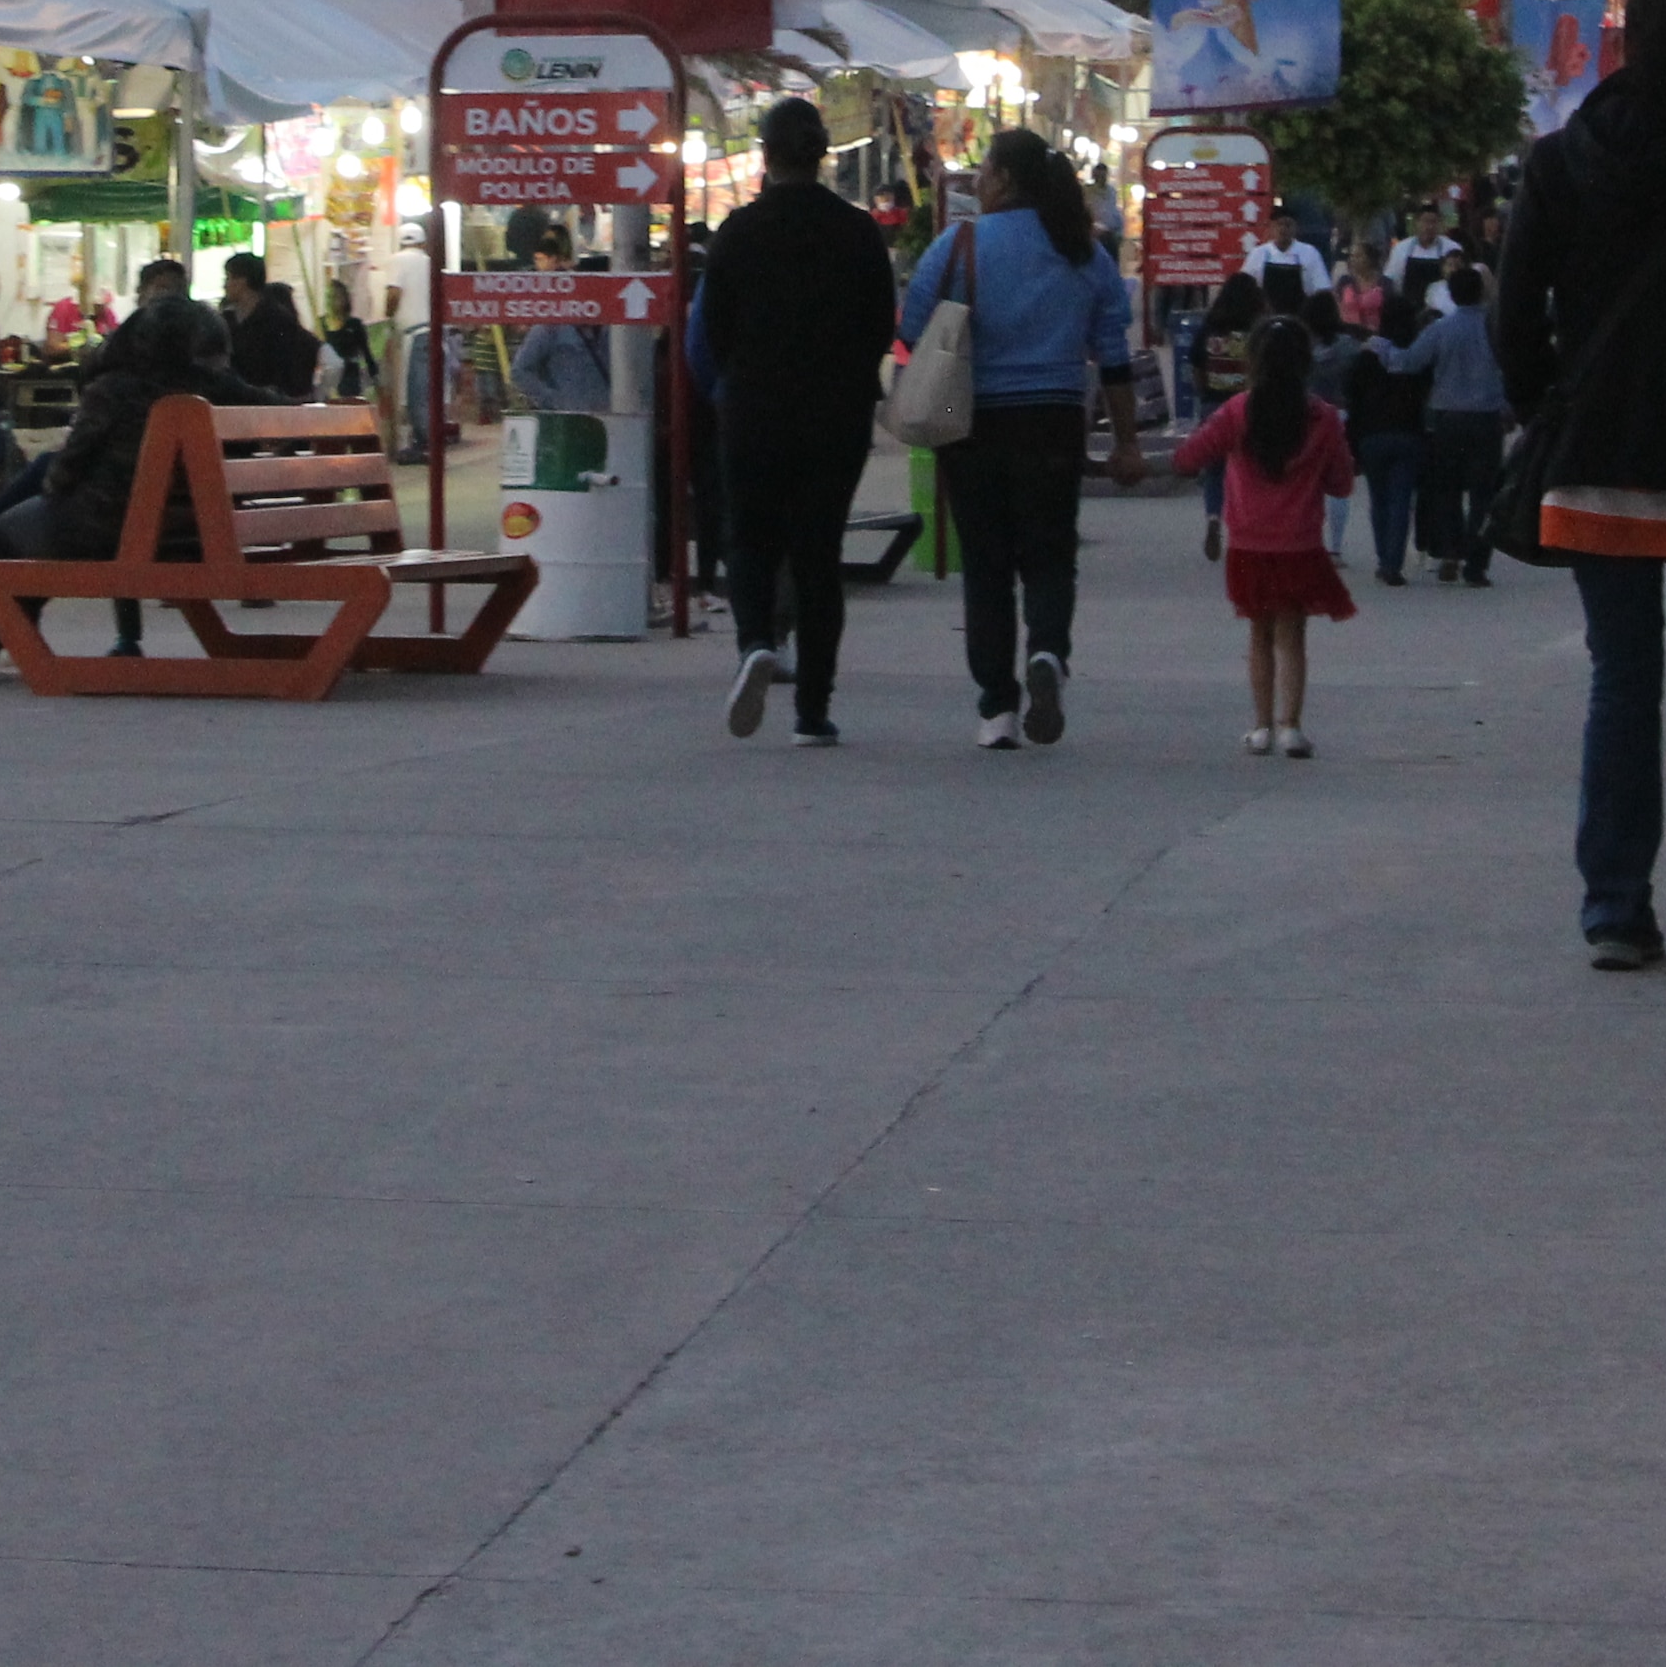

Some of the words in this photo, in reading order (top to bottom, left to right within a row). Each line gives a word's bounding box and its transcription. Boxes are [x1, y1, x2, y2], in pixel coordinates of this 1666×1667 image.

[465, 100, 598, 136] BAÑOS
[563, 156, 596, 175] DE
[479, 177, 572, 199] POLICÍA
[448, 300, 499, 318] TAXI
[504, 300, 602, 319] SEGURO
